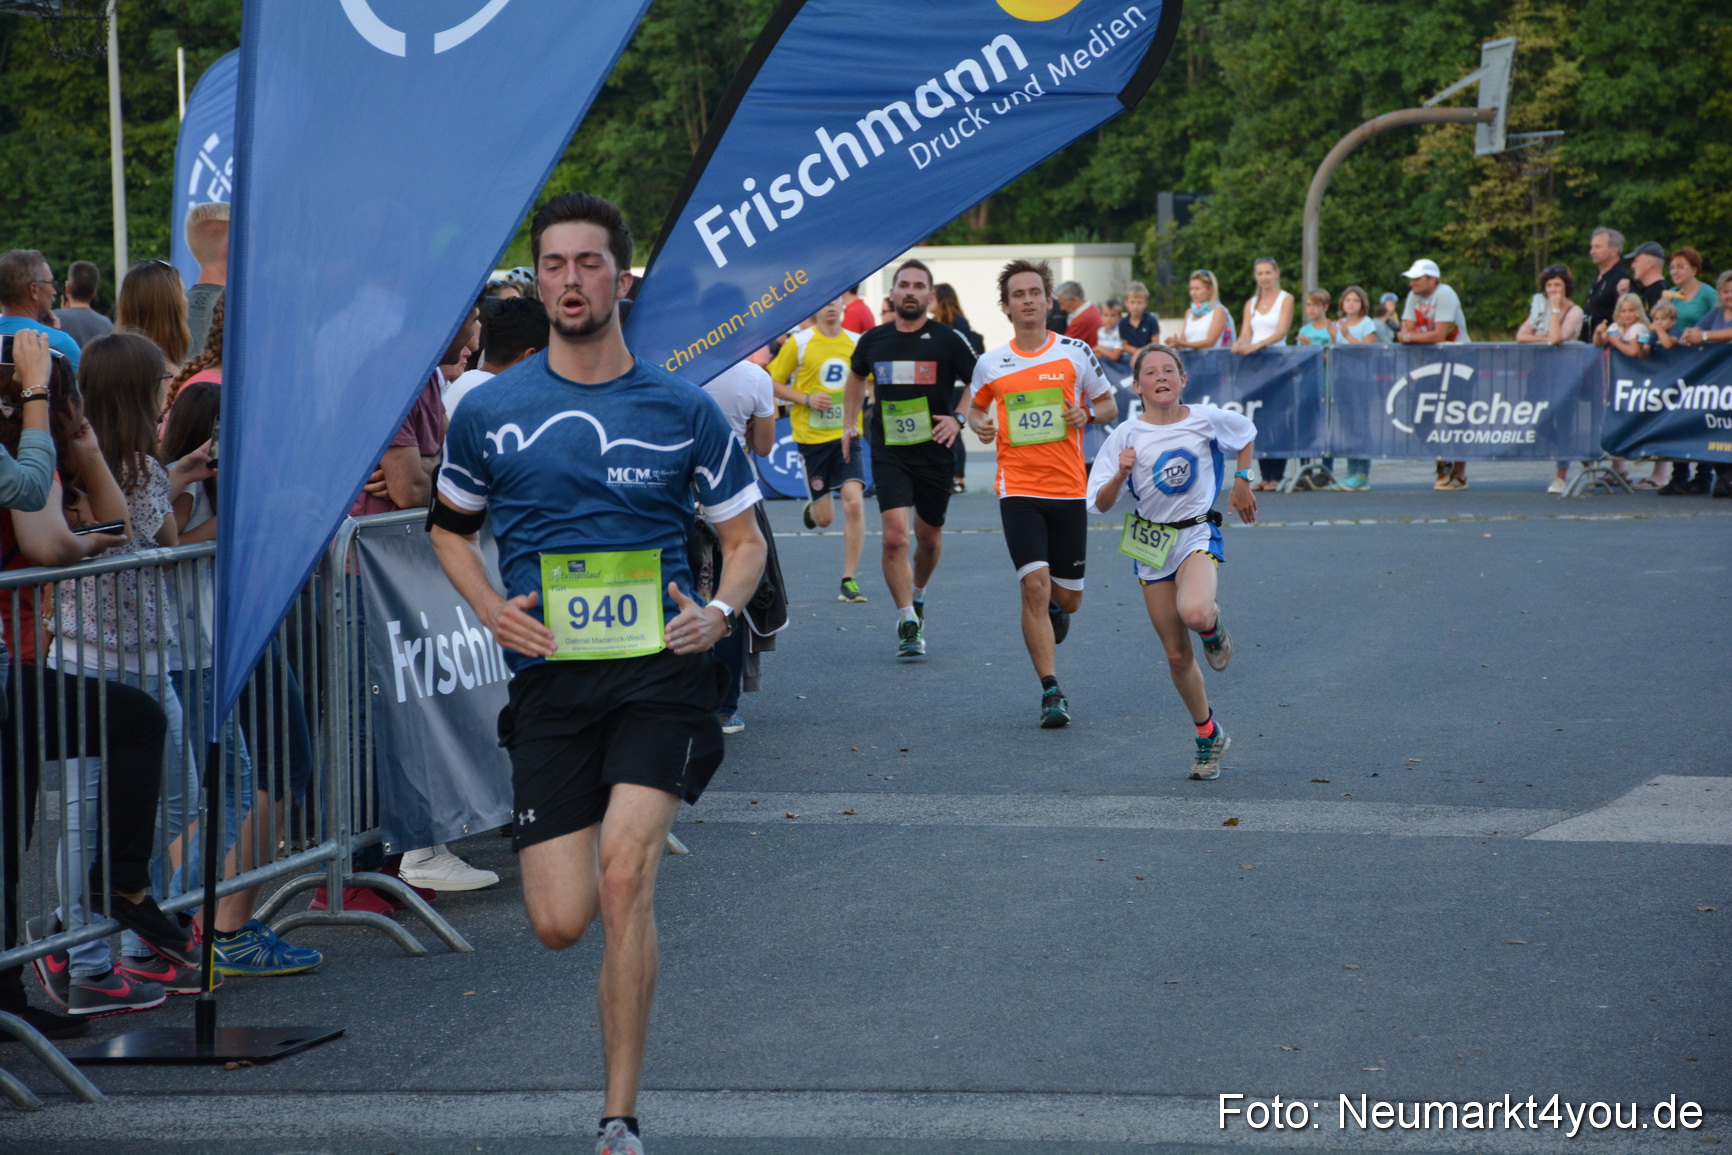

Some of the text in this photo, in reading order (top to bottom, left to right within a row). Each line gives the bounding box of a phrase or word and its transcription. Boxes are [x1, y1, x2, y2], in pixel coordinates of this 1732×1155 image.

[908, 5, 1147, 170] Druck und Medien
[694, 33, 1029, 268] Frischmann
[659, 269, 809, 372] chmann-net.de
[825, 364, 844, 382] B
[1614, 378, 1732, 412] Frischma
[1018, 410, 1054, 430] 492
[1414, 392, 1549, 425] Fischer
[895, 418, 916, 433] 39
[1705, 413, 1732, 429] Dru
[1426, 430, 1536, 444] AUTOMOBILE
[606, 467, 651, 482] MCM
[1130, 522, 1171, 551] 1597
[568, 594, 638, 630] 940
[565, 637, 590, 645] Gabriel
